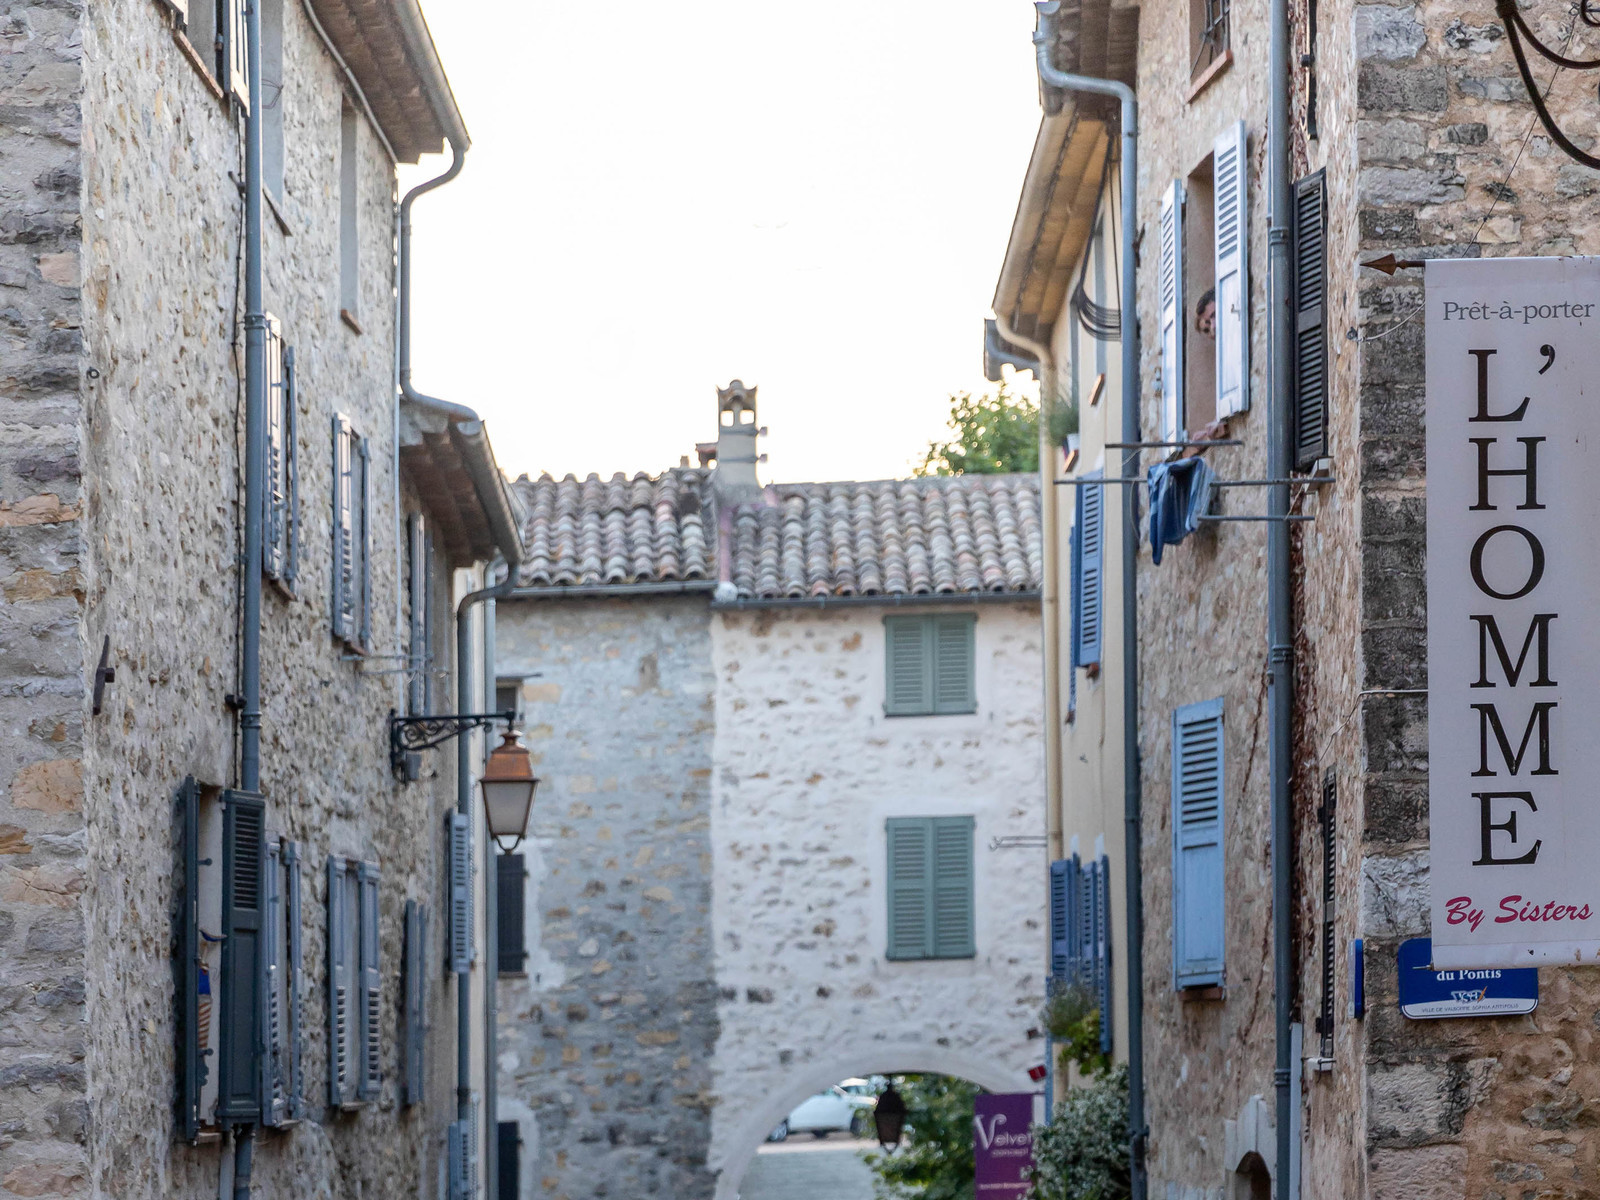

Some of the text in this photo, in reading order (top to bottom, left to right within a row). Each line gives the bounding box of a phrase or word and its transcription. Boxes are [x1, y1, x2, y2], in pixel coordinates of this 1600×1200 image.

[1442, 300, 1596, 325] Prêt-à-porter
[1444, 895, 1594, 933] By Sisters
[1436, 969, 1502, 981] du Pontis
